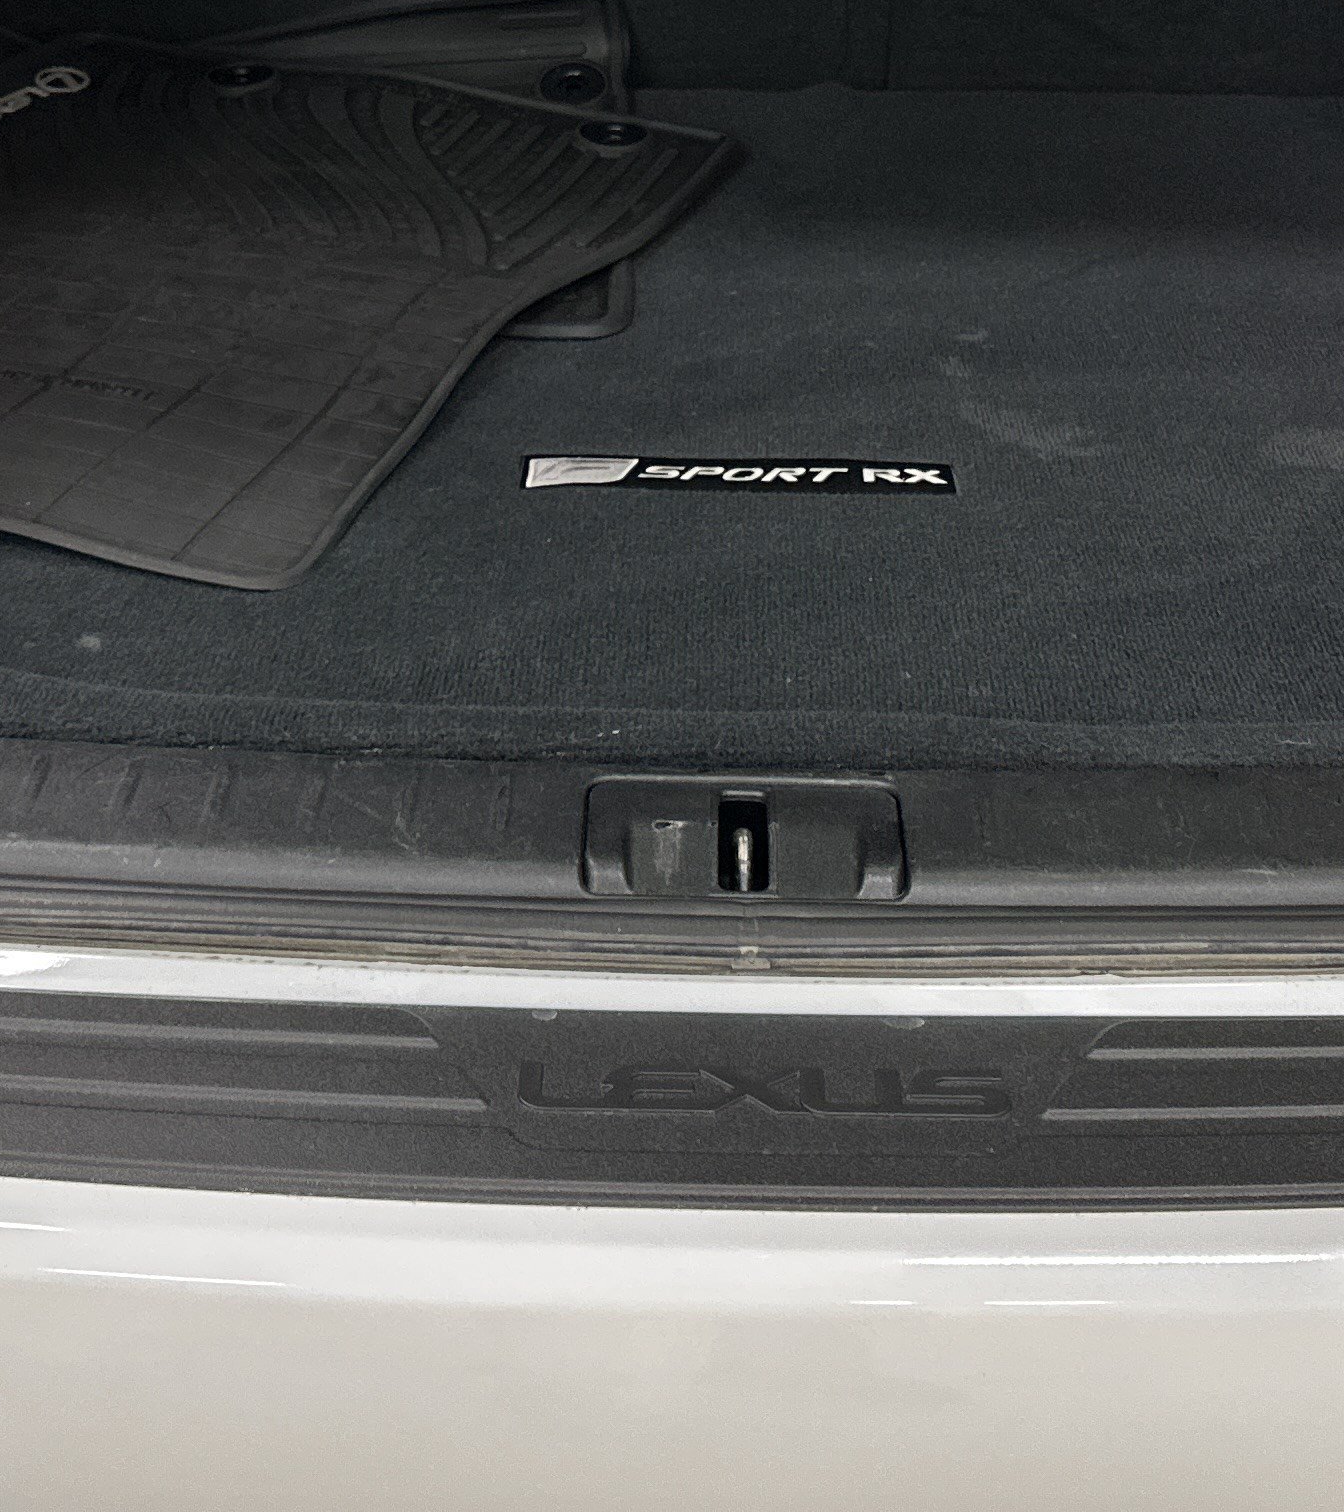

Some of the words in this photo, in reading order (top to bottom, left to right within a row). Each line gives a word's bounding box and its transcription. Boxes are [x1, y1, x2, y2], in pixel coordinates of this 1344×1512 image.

[637, 464, 849, 484] SPORT
[862, 467, 949, 485] RX
[518, 1062, 1012, 1119] LEXUS
